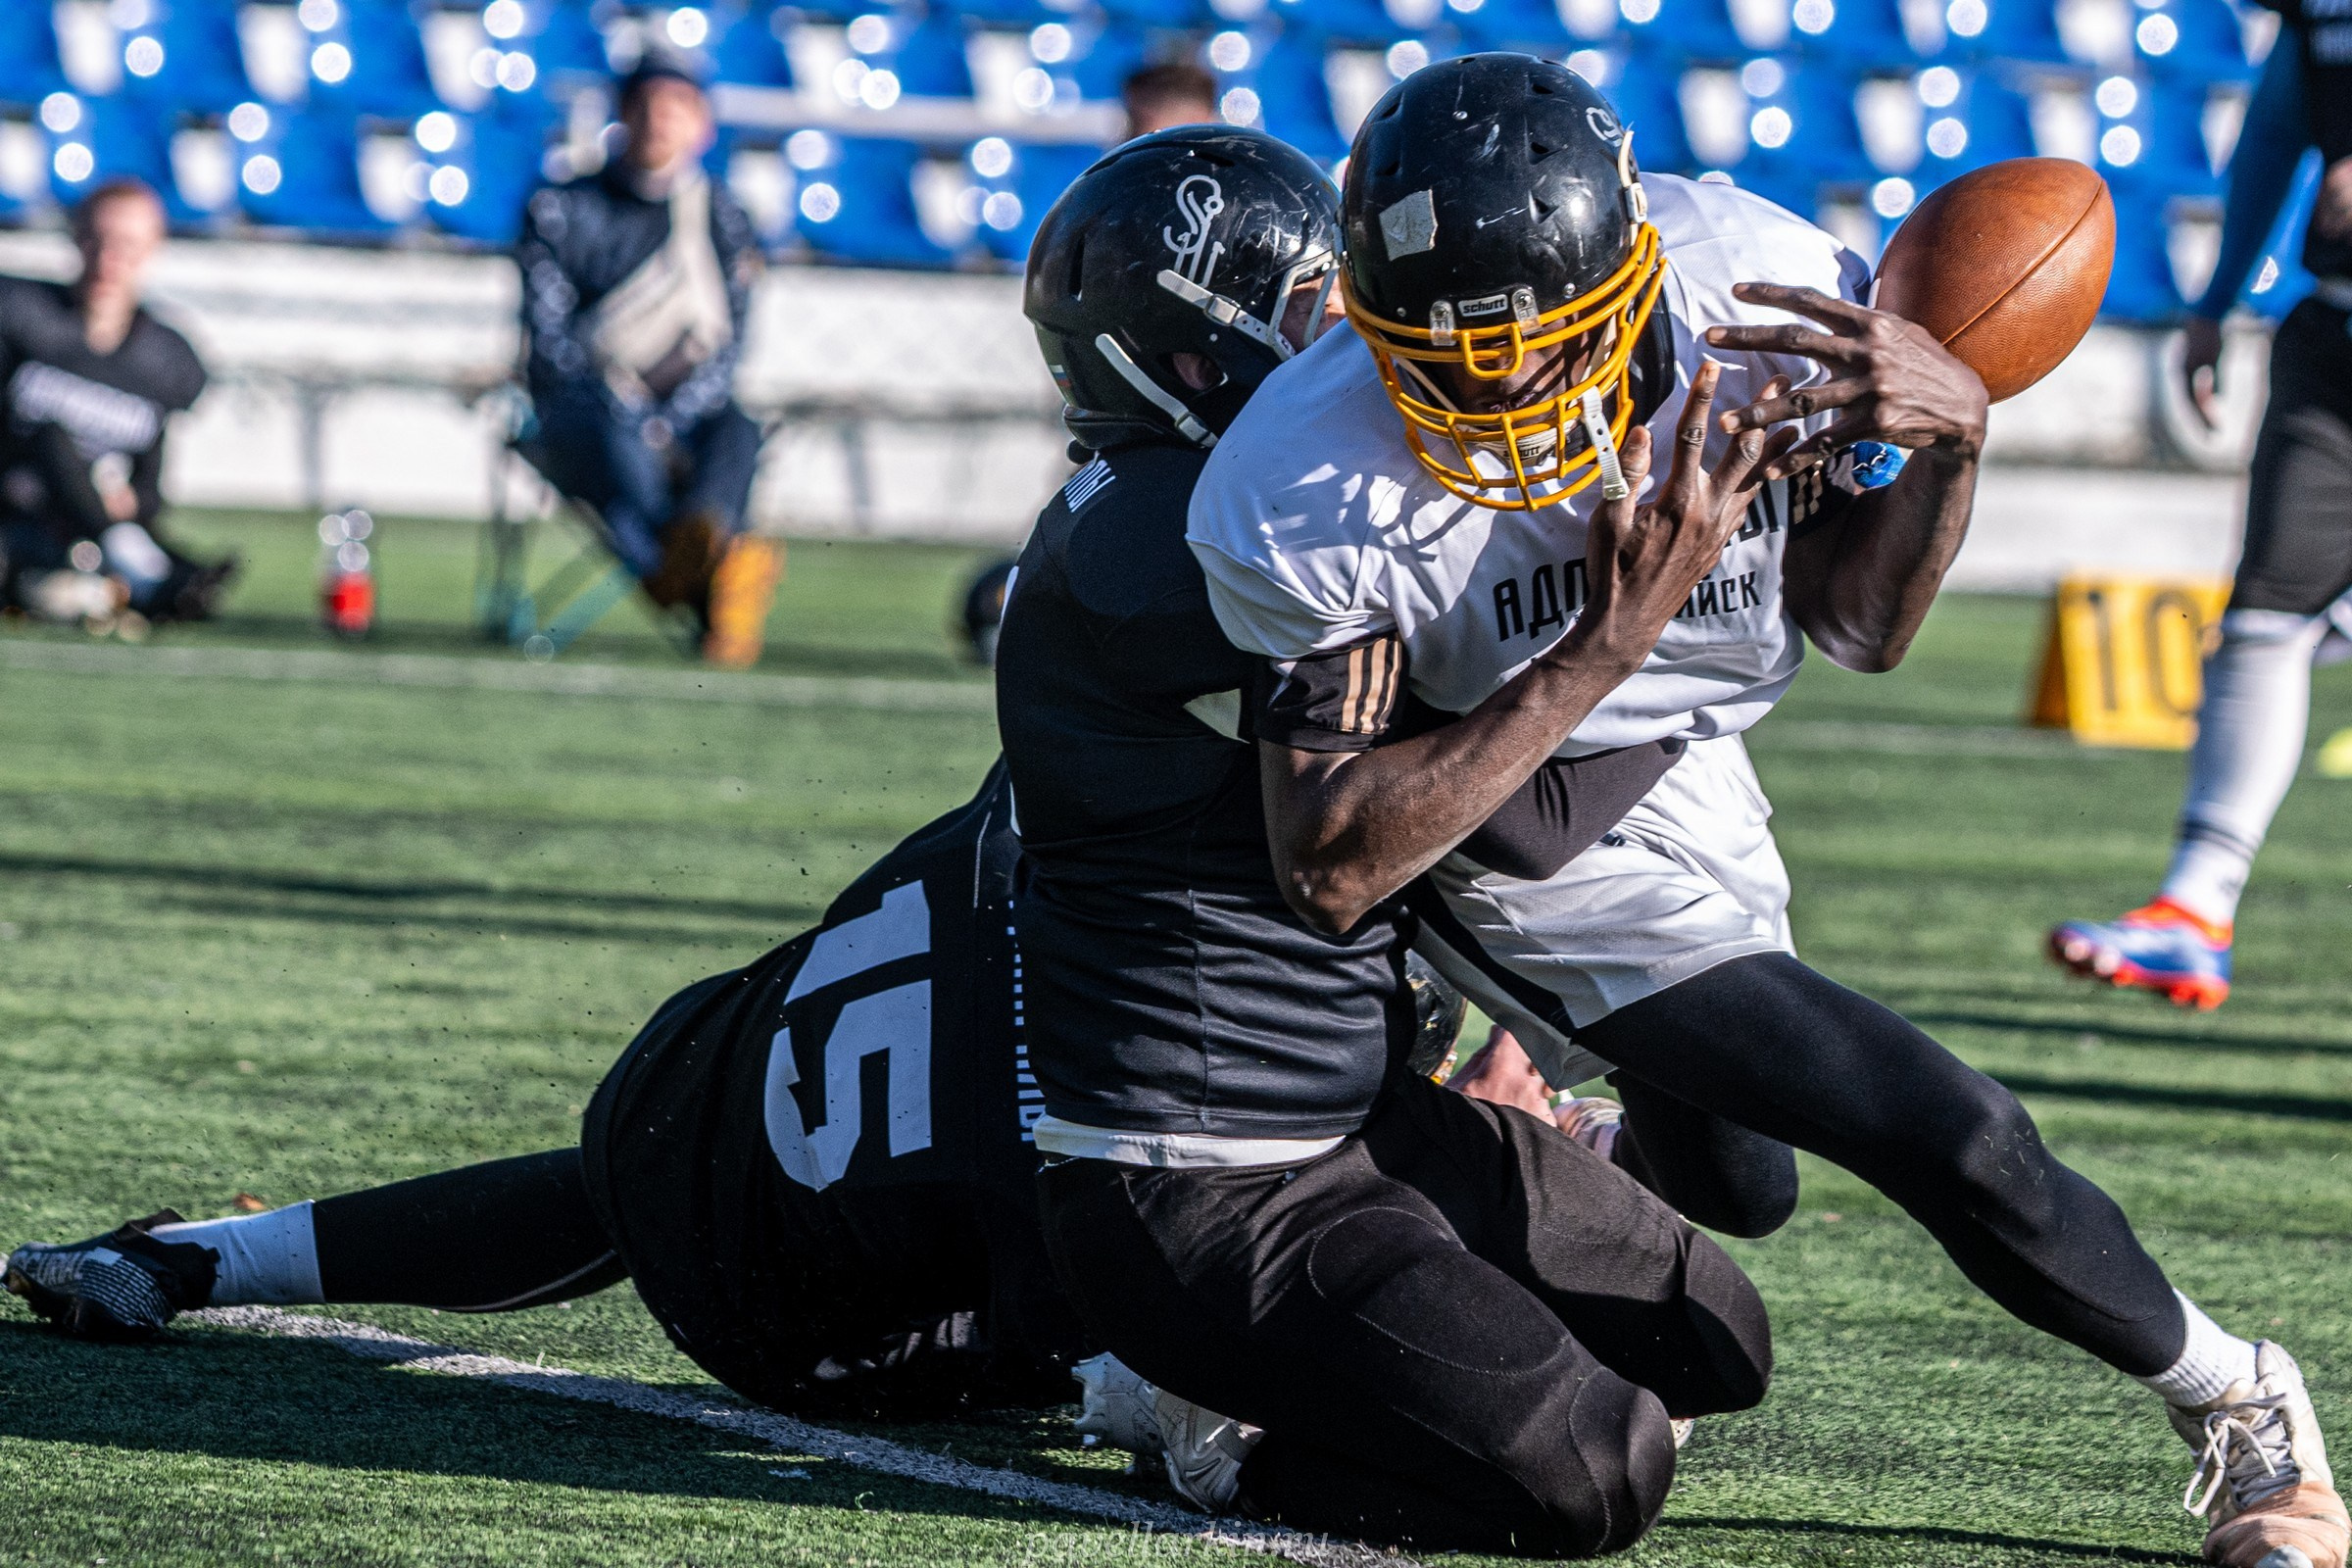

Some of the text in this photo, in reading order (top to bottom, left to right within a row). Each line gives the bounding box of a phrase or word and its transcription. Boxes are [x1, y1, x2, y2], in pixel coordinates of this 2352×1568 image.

[1463, 298, 1505, 314] schutt
[2080, 589, 2203, 721] 10
[763, 879, 932, 1193] 15
